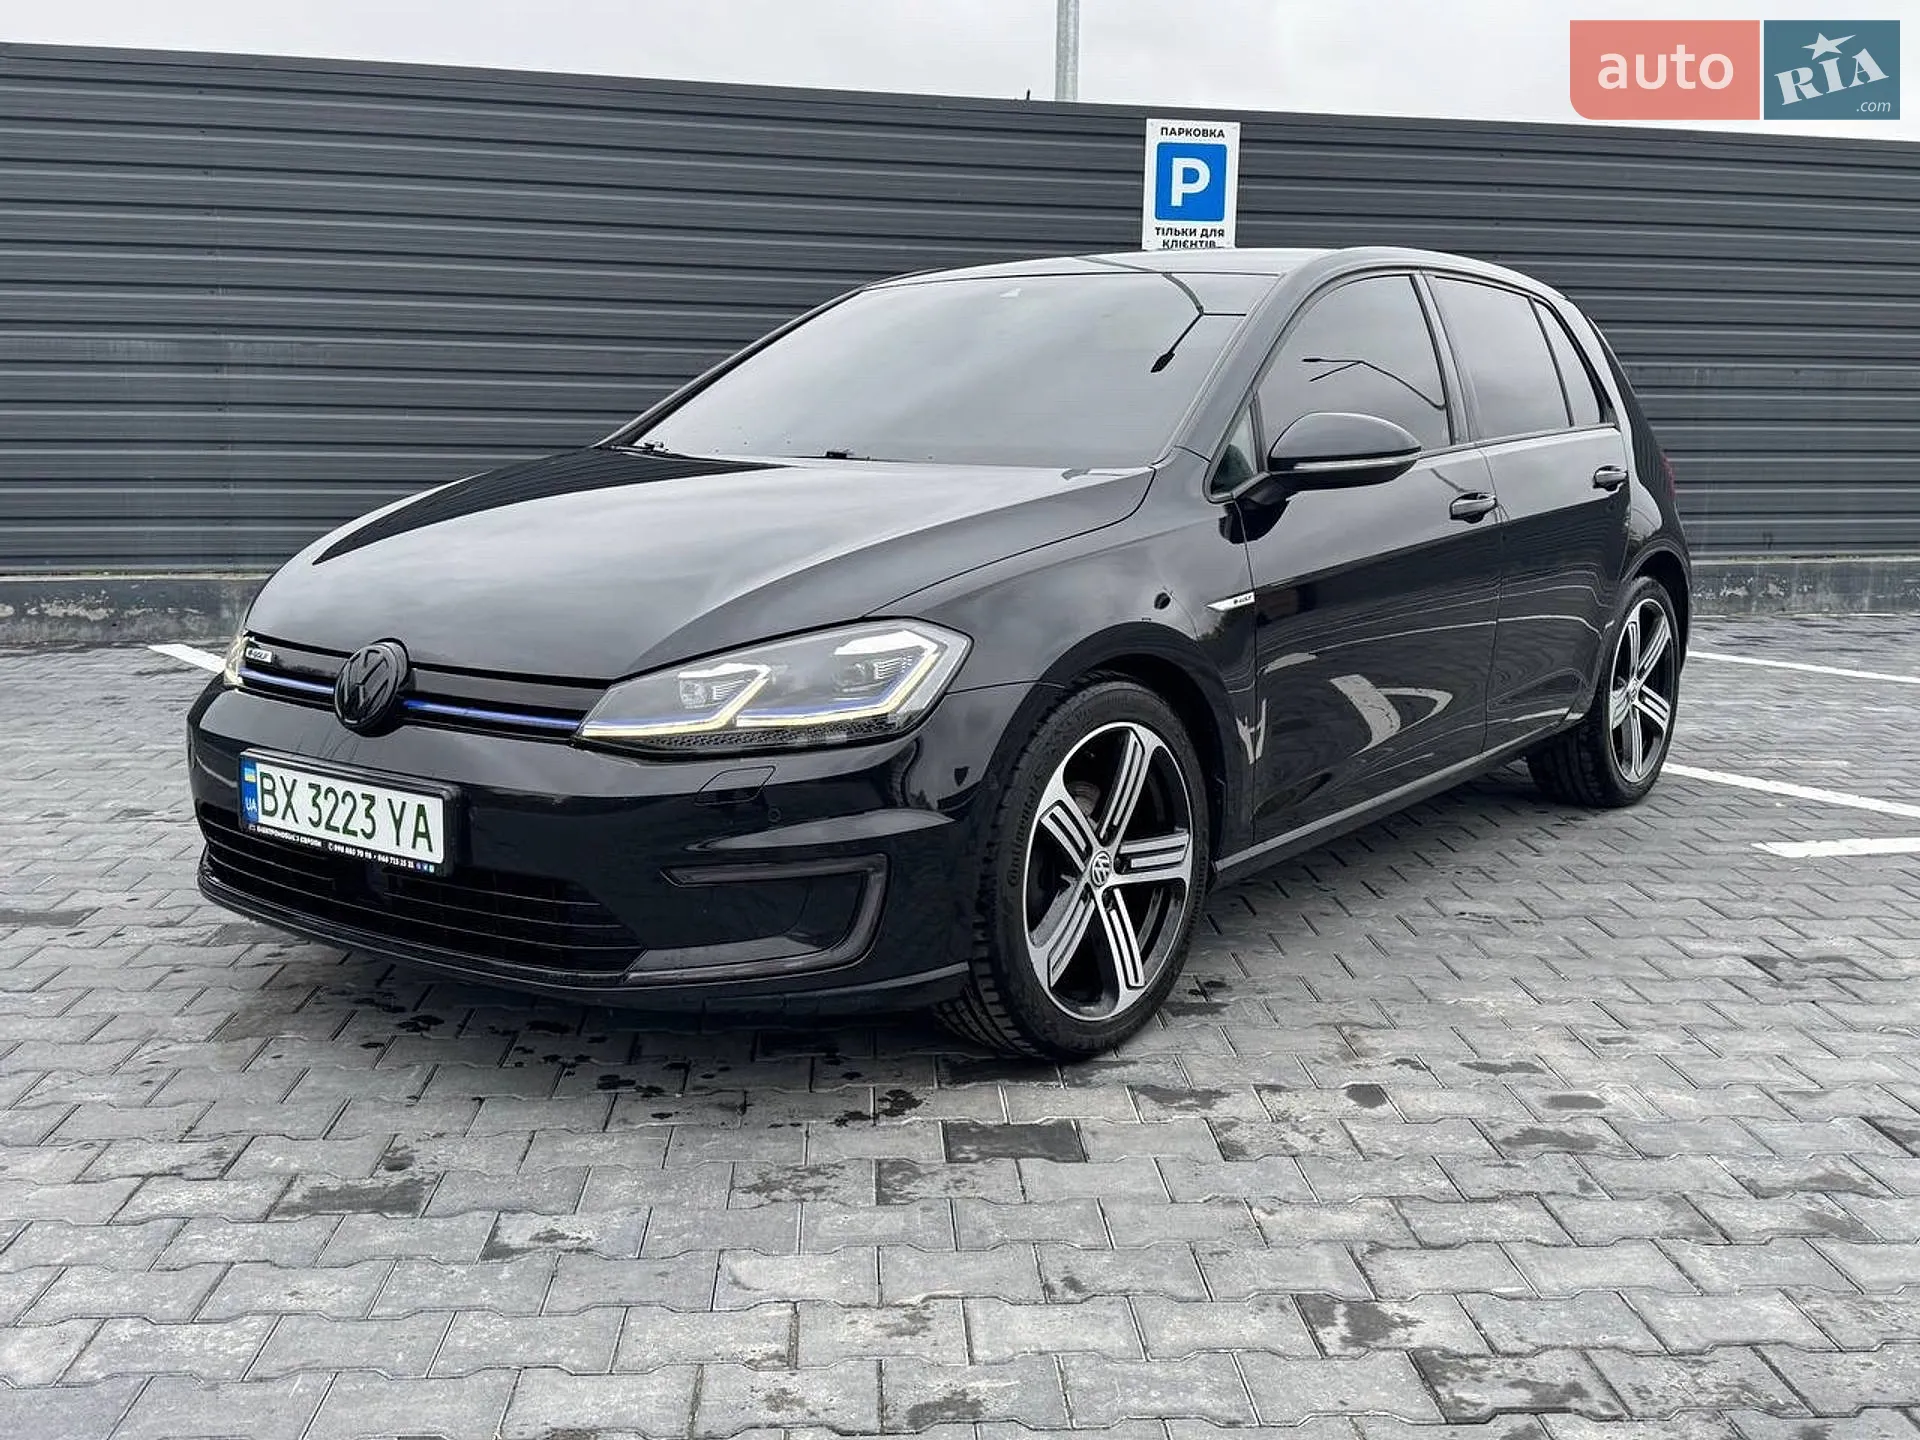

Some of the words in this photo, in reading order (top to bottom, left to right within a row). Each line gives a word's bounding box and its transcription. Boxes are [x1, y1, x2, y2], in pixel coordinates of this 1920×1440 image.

[1160, 127, 1225, 138] ПАРКОВКА
[1171, 157, 1211, 207] P
[1155, 227, 1197, 237] ТІЛЬКИ
[1200, 228, 1225, 239] ДЛЯ
[1162, 239, 1216, 249] КЛІЄНТІВ
[244, 796, 257, 812] UA
[260, 772, 299, 824] BX
[308, 783, 376, 840] 3223
[387, 798, 433, 852] YA
